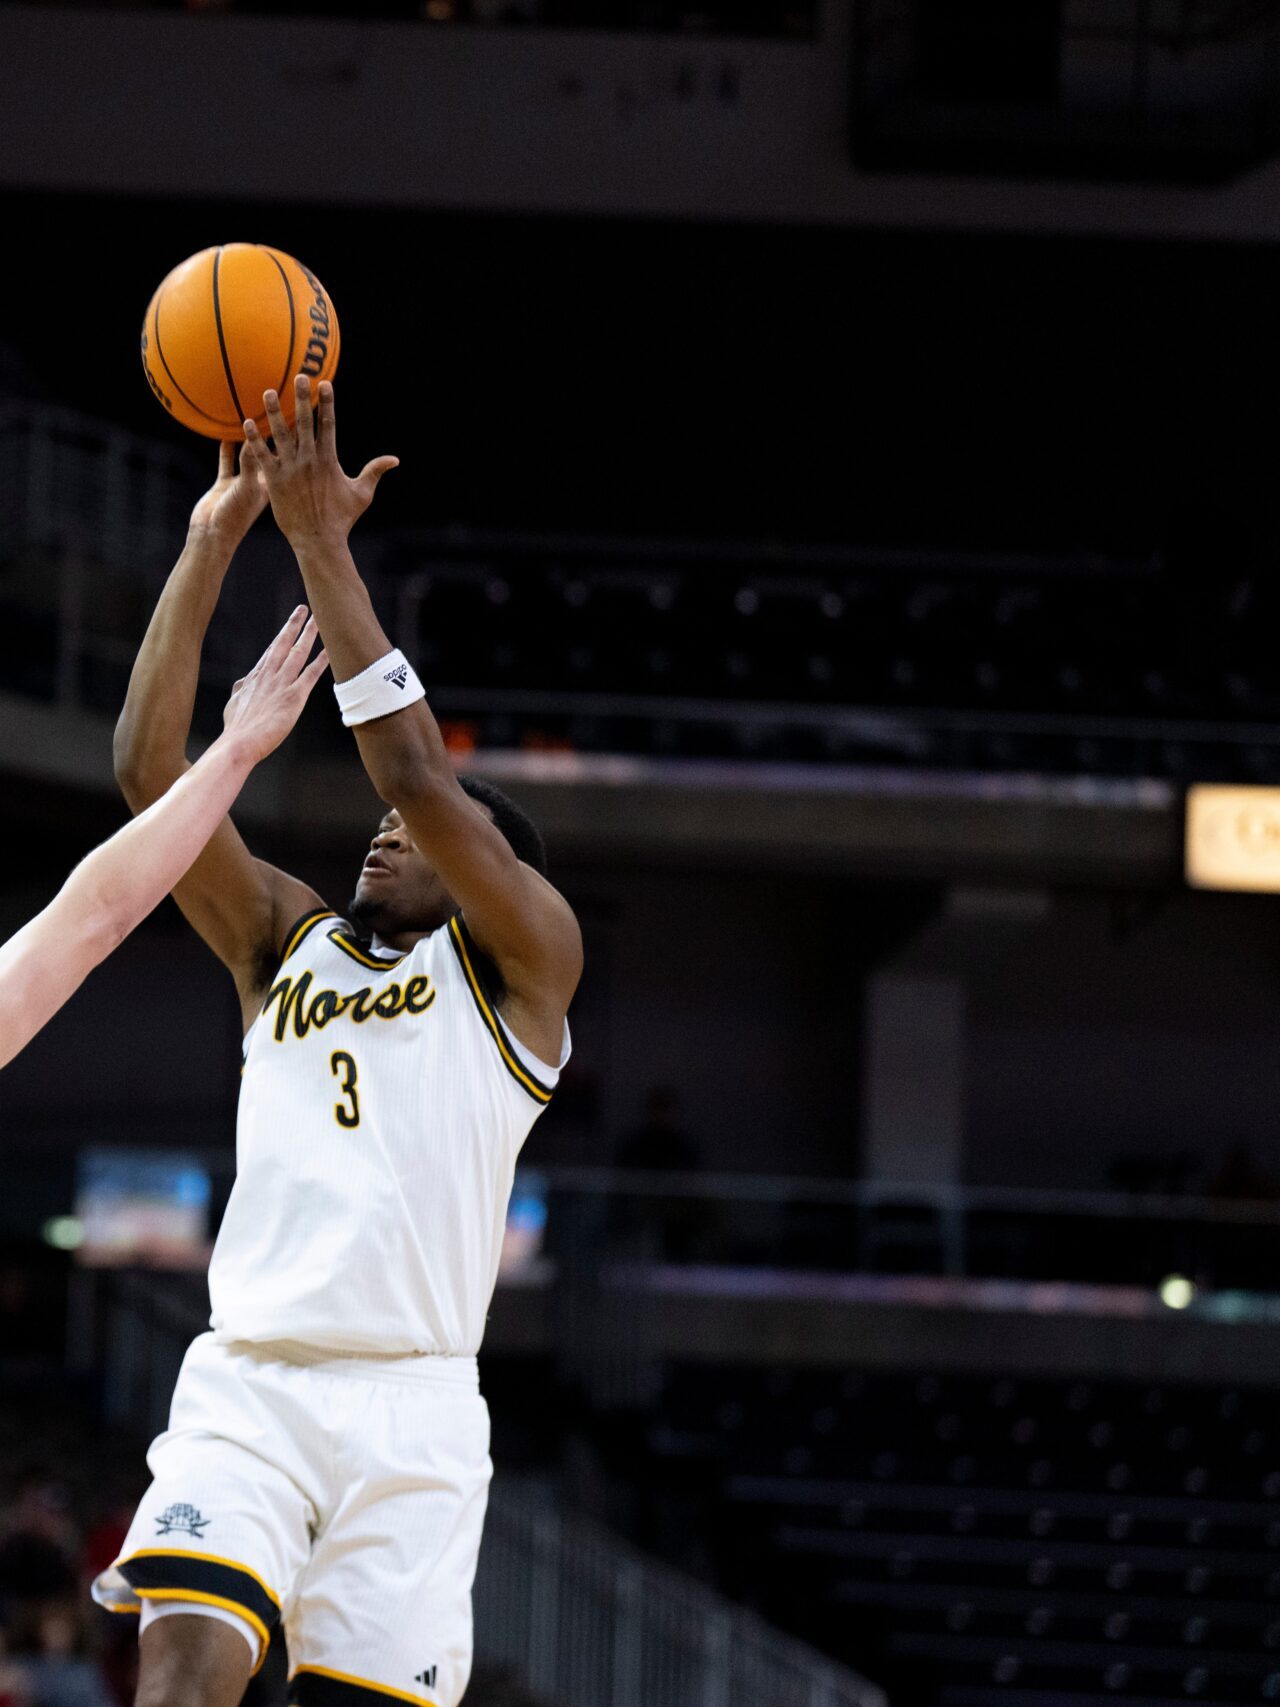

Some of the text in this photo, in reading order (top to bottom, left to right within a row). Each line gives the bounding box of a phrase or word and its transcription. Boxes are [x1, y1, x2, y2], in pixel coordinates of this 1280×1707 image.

[384, 664, 406, 682] adidas
[263, 970, 435, 1042] Norse
[331, 1049, 360, 1129] 3
